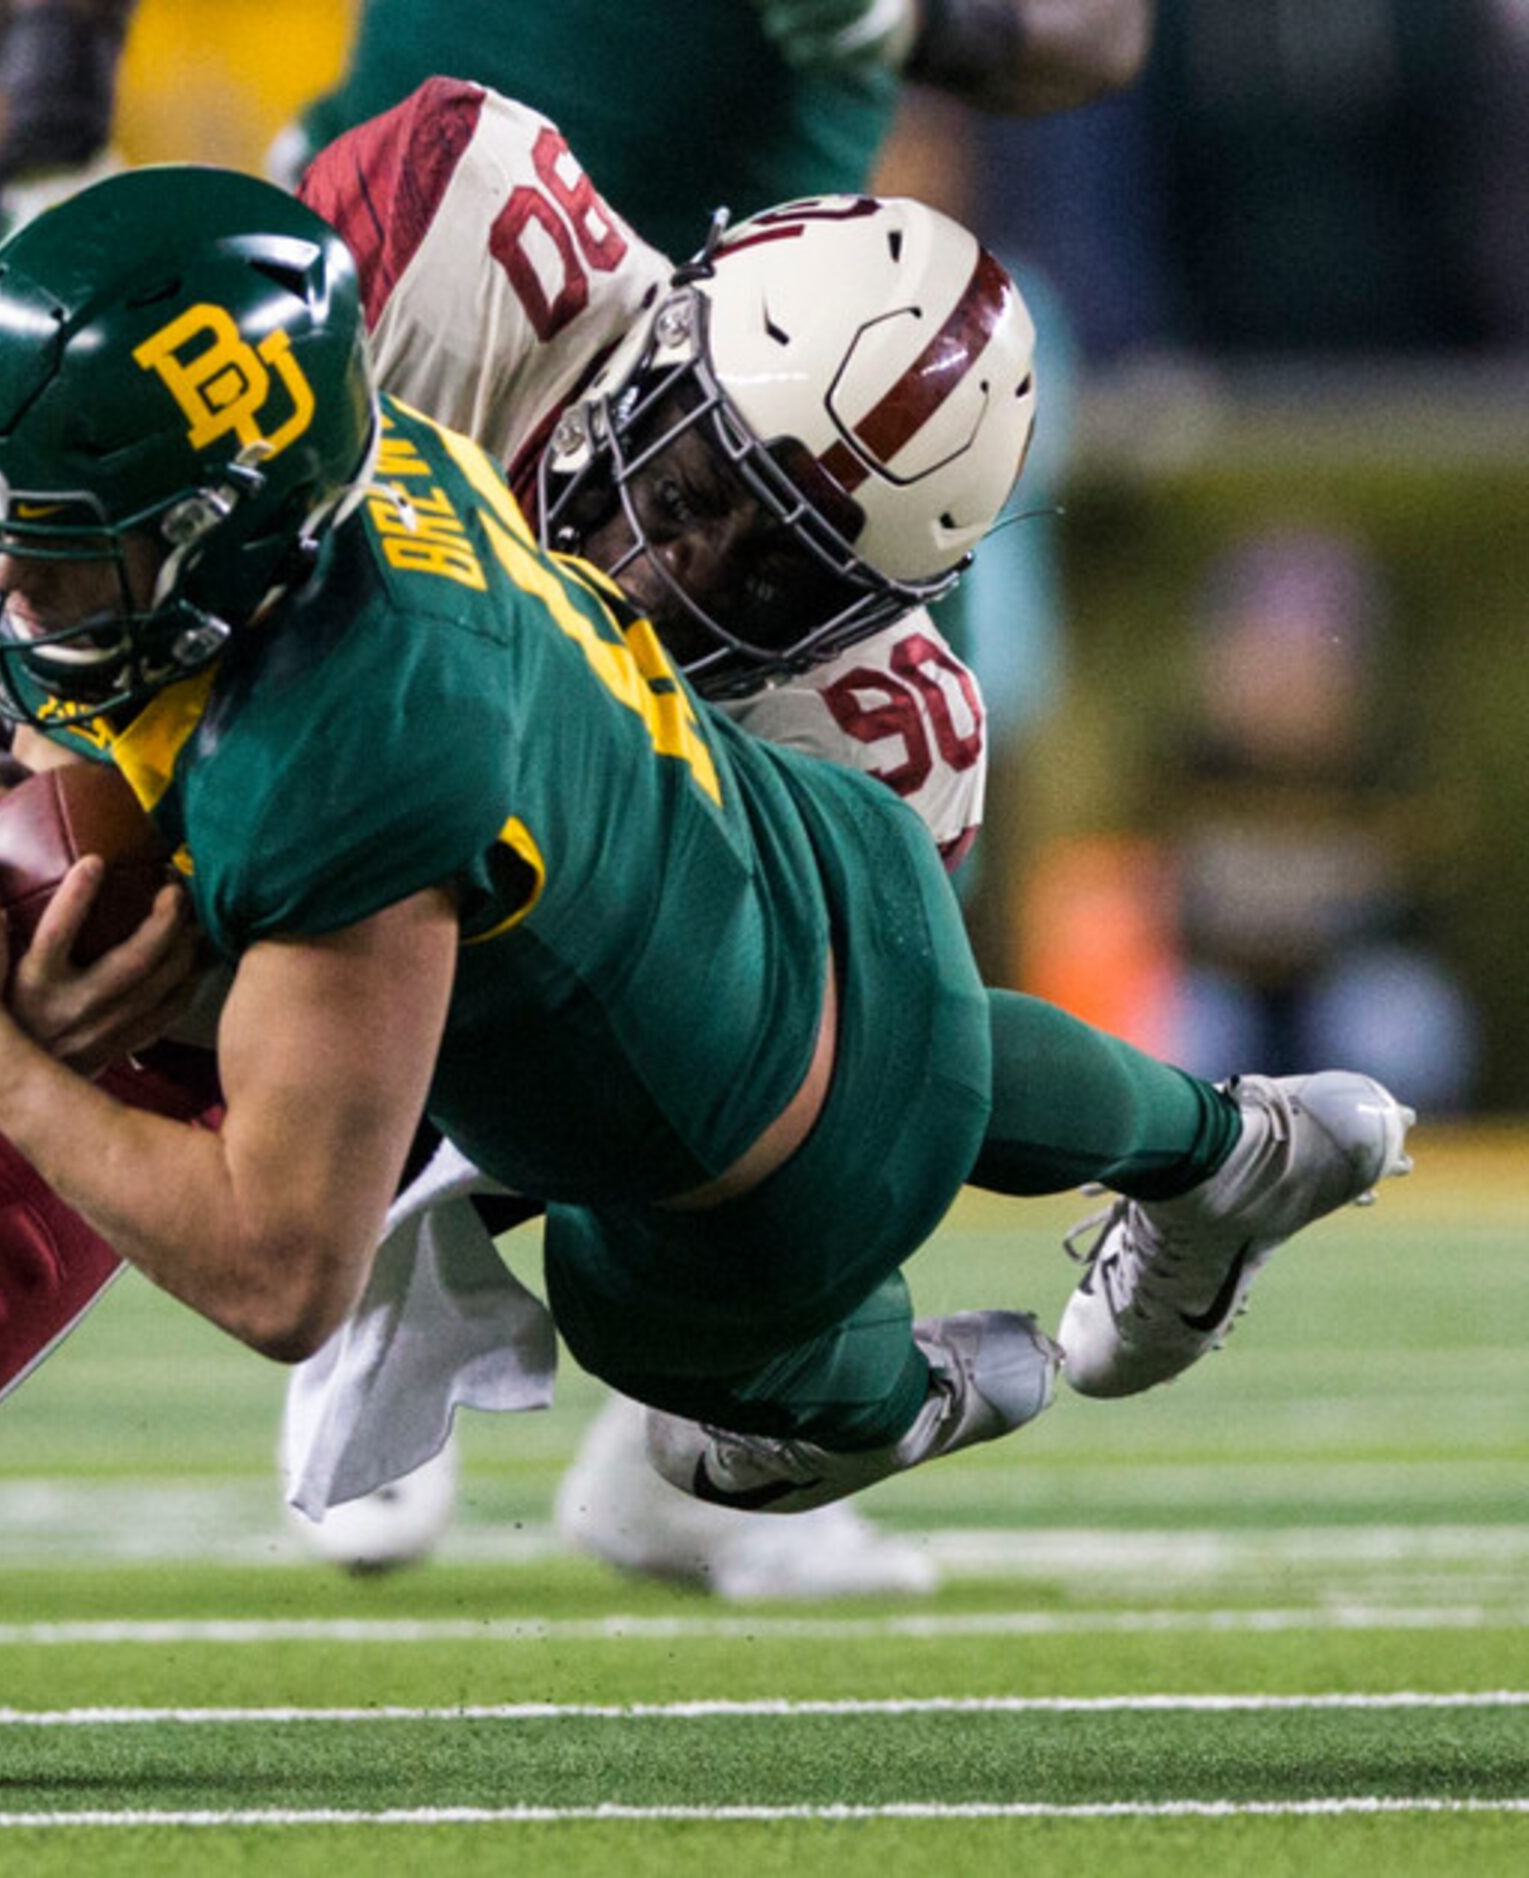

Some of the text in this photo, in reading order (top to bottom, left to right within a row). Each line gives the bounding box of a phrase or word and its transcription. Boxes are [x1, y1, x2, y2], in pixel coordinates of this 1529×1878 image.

[131, 303, 315, 461] BU
[366, 414, 488, 592] BREW
[822, 632, 983, 798] 90
